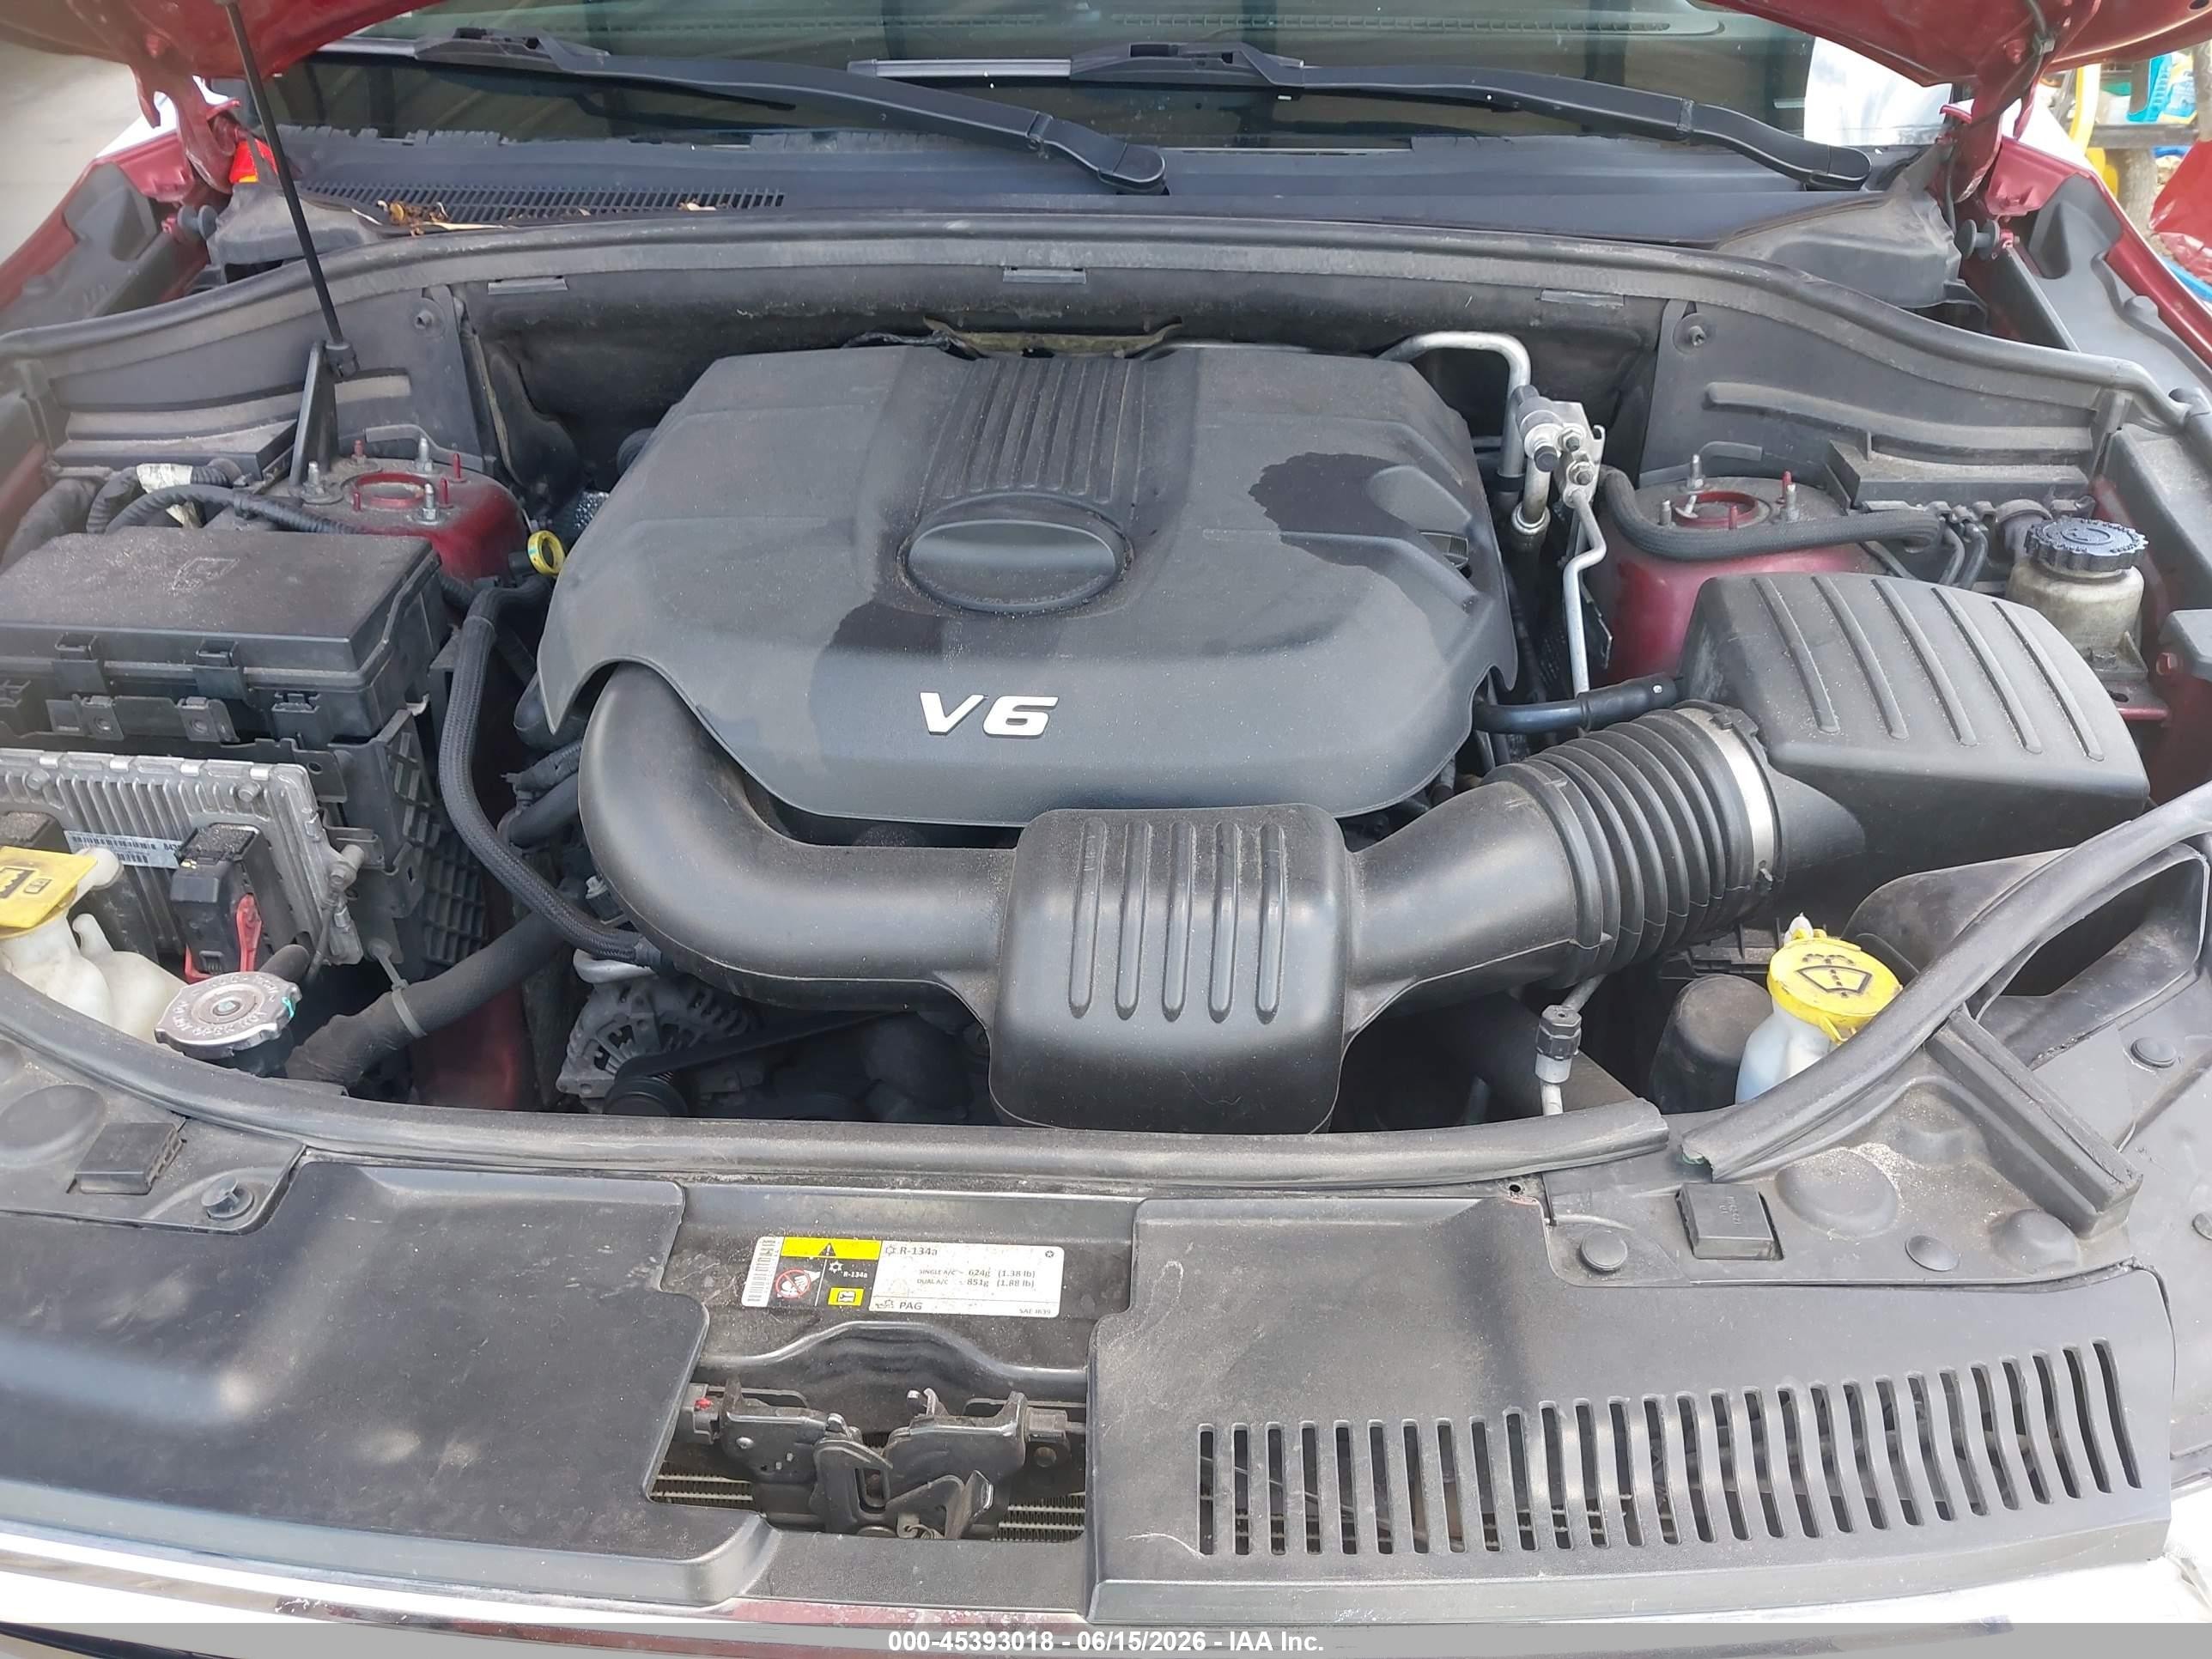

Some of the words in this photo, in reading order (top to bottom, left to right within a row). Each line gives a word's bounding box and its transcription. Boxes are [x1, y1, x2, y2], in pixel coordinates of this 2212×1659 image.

[920, 691, 1060, 740] V6
[900, 1246, 938, 1255] R-134a
[969, 1269, 990, 1278] 624g
[1023, 1270, 1036, 1279] lb)
[967, 1279, 989, 1287] 851g
[899, 1302, 923, 1310] PAG
